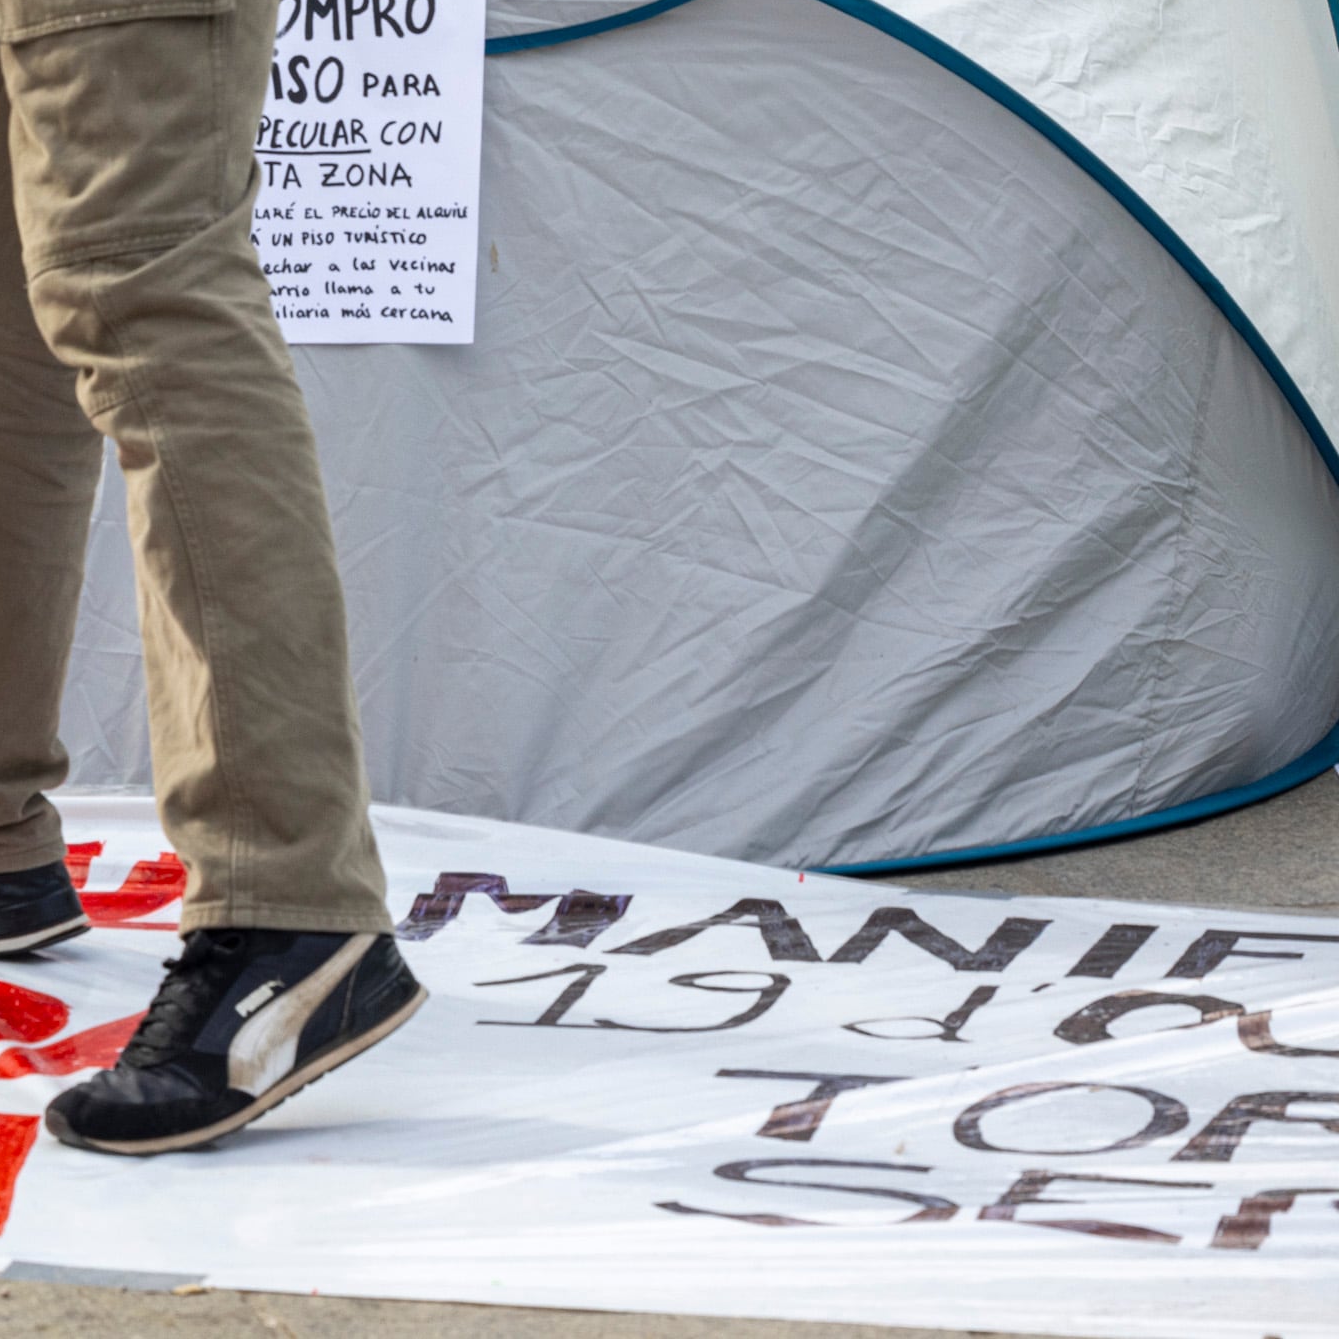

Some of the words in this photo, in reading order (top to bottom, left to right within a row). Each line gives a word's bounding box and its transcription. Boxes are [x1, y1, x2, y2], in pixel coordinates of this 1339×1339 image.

[271, 48, 344, 104] ISO
[363, 72, 441, 98] PARA
[256, 115, 369, 150] PECULAR
[380, 120, 443, 146] CON
[263, 160, 302, 190] TA
[318, 162, 413, 188] ZONA
[254, 201, 296, 220] LARÉ
[304, 208, 323, 220] EL
[386, 207, 411, 220] DEL
[271, 232, 294, 247] UN
[328, 262, 341, 273] a
[352, 257, 376, 271] las
[325, 280, 374, 295] llama
[390, 285, 402, 295] a
[414, 282, 435, 295] tu
[275, 303, 330, 320] iliaria
[341, 302, 372, 319] más
[380, 305, 454, 323] cercana
[473, 962, 792, 1033] 19
